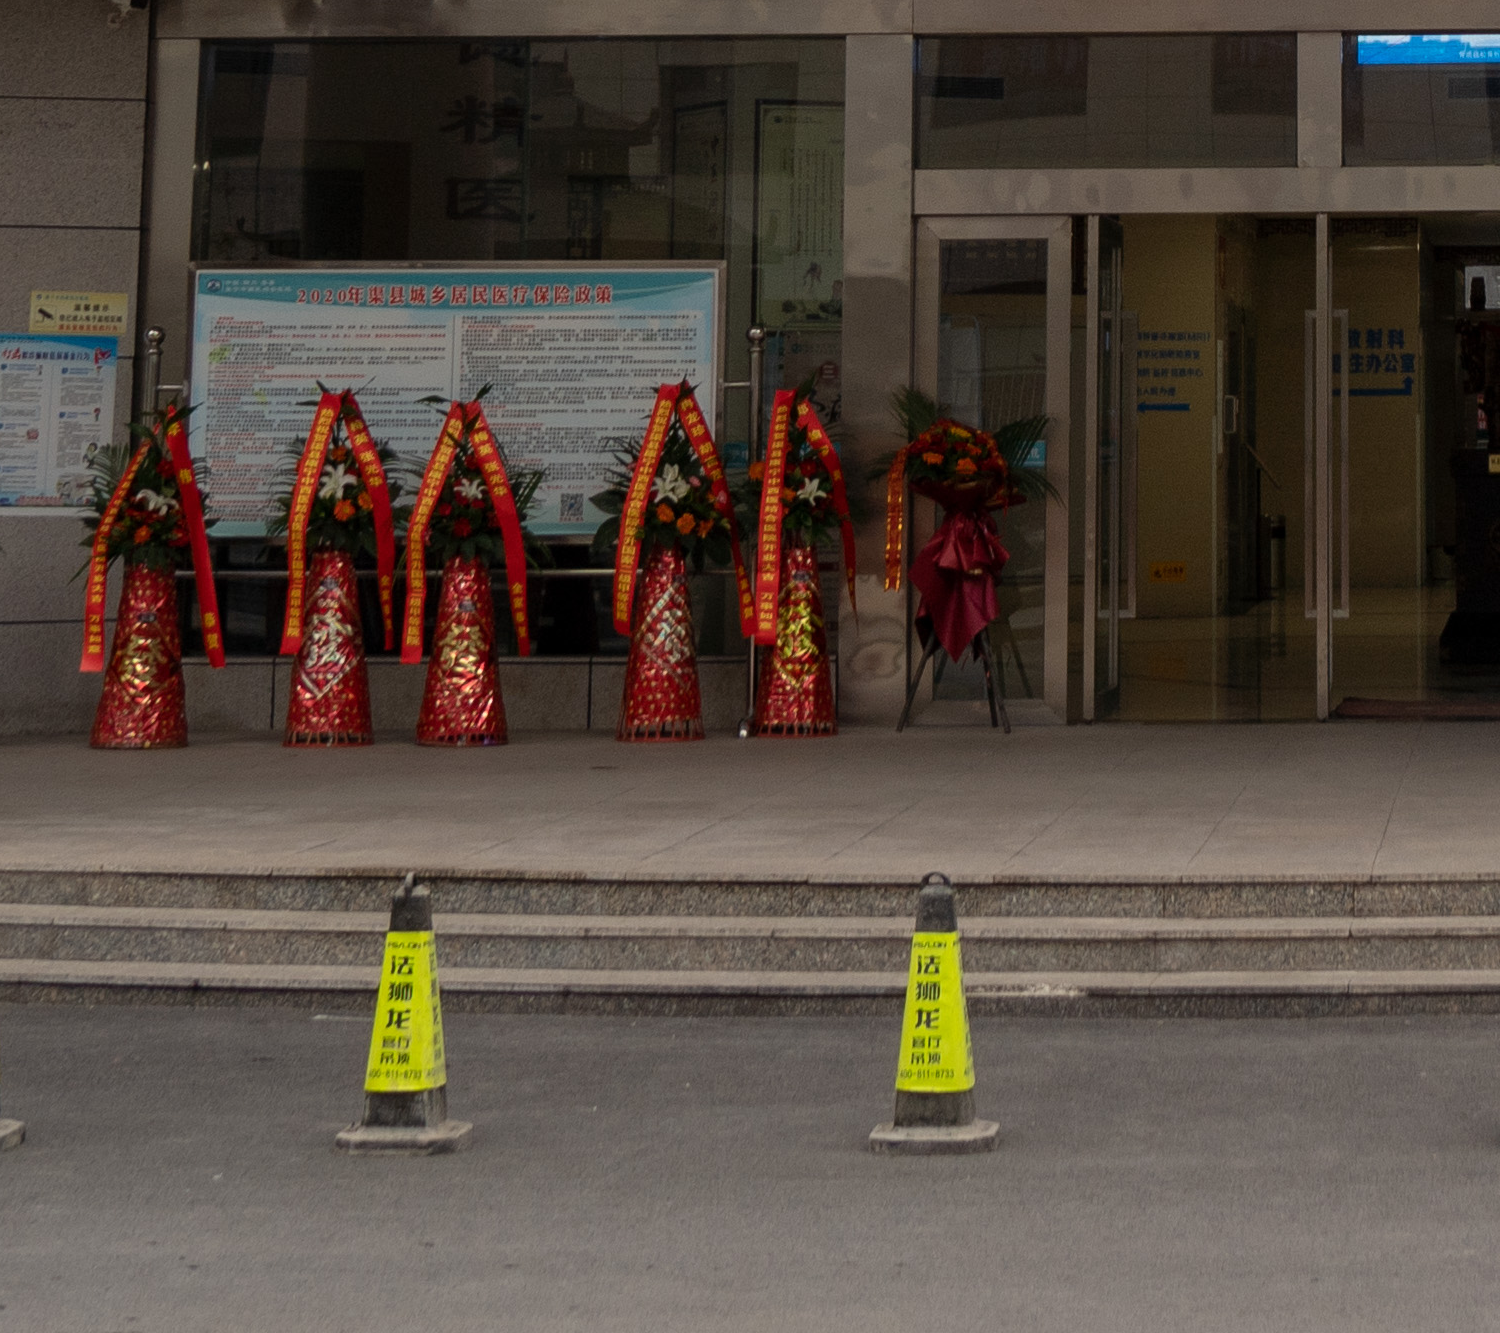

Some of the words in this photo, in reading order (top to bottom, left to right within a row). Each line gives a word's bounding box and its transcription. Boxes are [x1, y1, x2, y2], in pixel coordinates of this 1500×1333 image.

[296, 284, 614, 305] 2020年渠县城乡居民医疗保险政策
[385, 955, 415, 1030] 法狮龙
[914, 954, 941, 1030] 法狮龙
